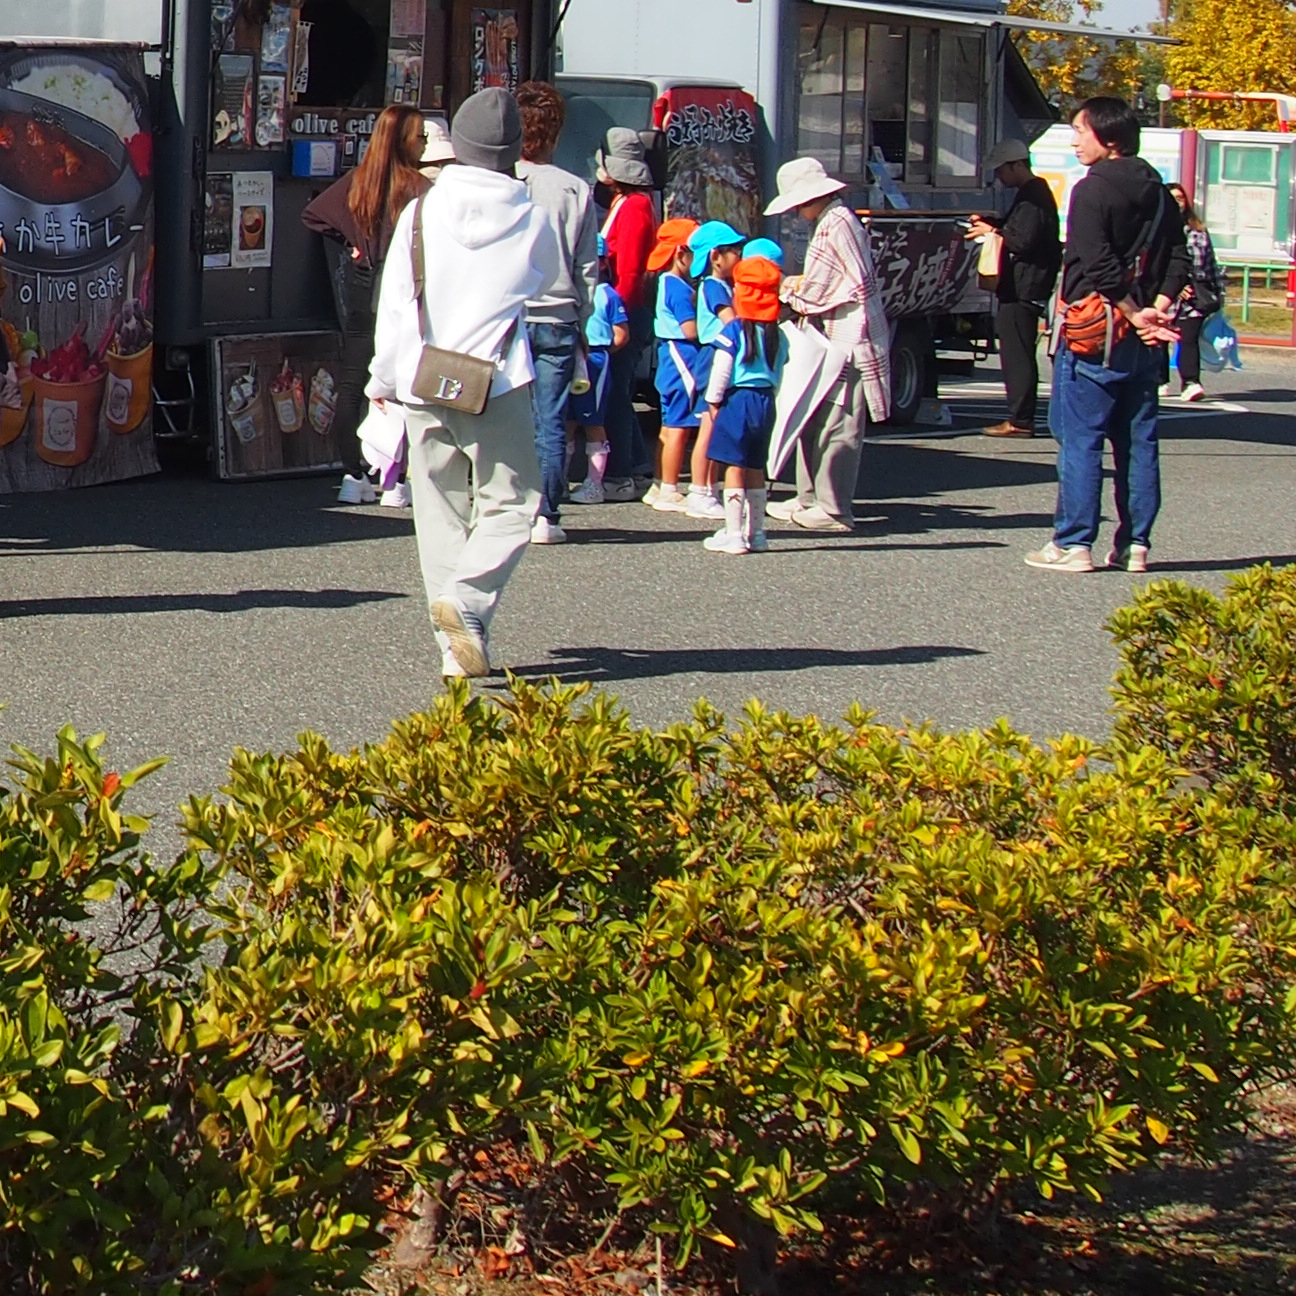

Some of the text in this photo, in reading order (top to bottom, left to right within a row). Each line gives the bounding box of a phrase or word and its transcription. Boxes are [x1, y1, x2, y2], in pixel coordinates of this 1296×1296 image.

[291, 113, 376, 134] olive caf
[19, 267, 124, 303] olive cafe
